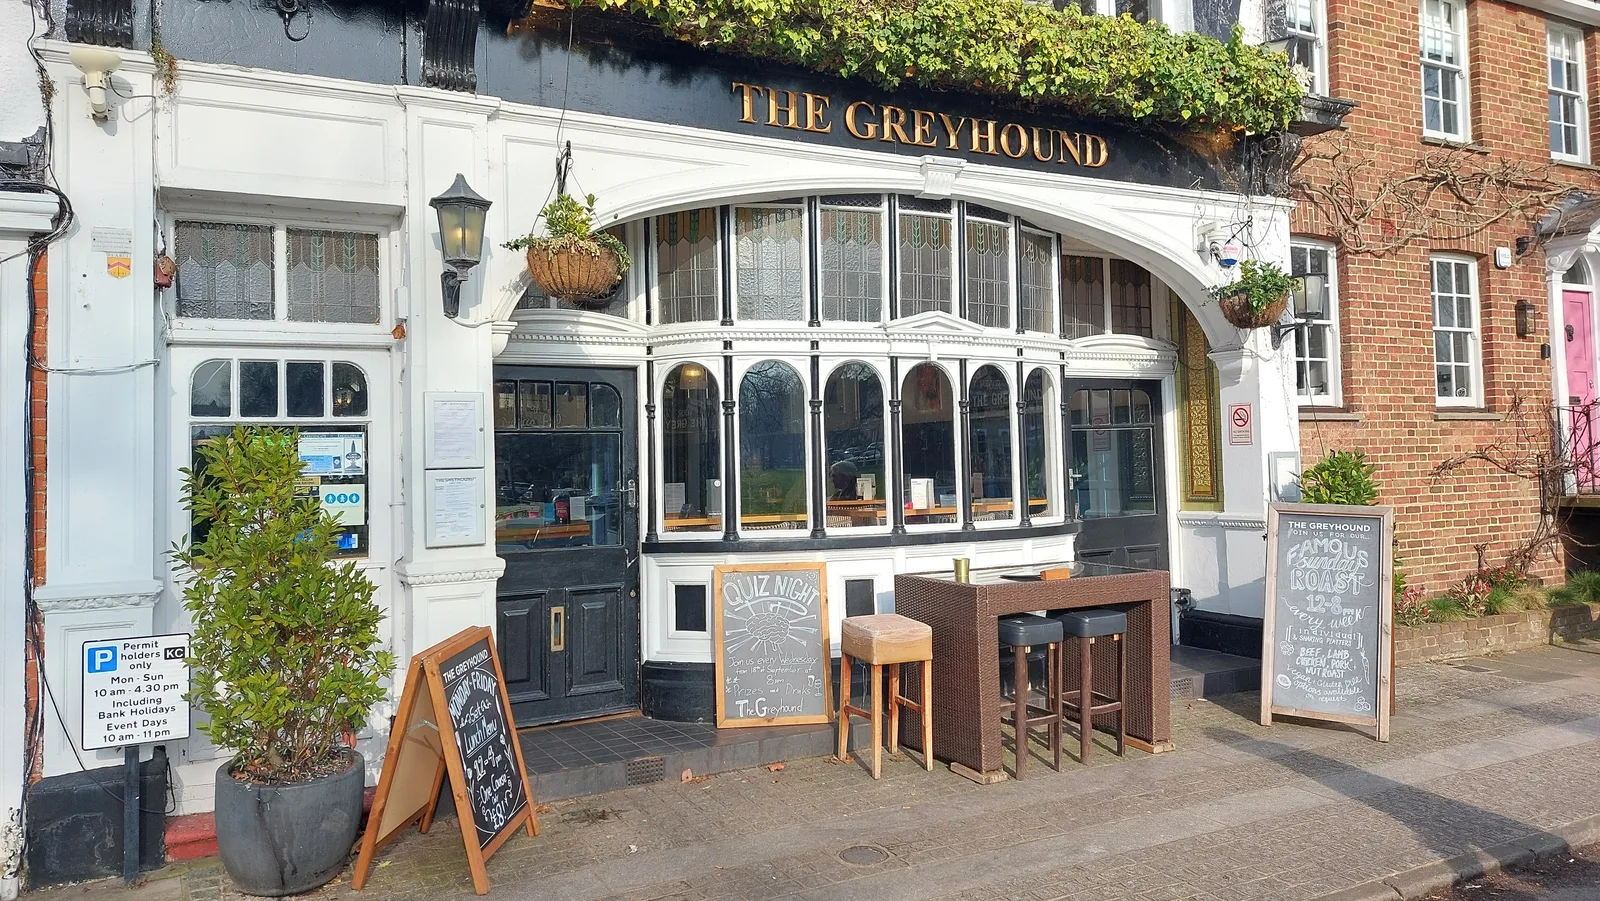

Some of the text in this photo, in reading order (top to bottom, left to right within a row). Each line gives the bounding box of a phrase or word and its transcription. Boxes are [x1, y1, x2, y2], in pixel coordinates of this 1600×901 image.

[732, 81, 1109, 168] THE GREYHOUND
[1288, 521, 1371, 532] THE GREYHOUND
[1286, 537, 1369, 567] FAMOUS
[1290, 568, 1365, 595] ROAST
[723, 575, 820, 607] QUIZ NIGHT
[1289, 605, 1364, 630] every week
[1299, 635, 1323, 643] SHARING
[123, 641, 159, 651] Permit
[95, 650, 113, 670] P
[121, 651, 161, 661] holders
[166, 648, 184, 659] KC
[129, 661, 152, 670] only
[443, 649, 488, 683] THE GREYHOUND
[728, 656, 744, 668] Join
[745, 657, 754, 666] us
[757, 657, 777, 666] every
[111, 677, 134, 685] Mon
[143, 673, 164, 682] Sun
[1306, 667, 1346, 679] NUT ROAST
[94, 689, 107, 698] 10
[109, 688, 126, 696] am
[134, 684, 161, 694] 4.30
[163, 683, 179, 692] pm
[733, 684, 764, 697] Prizes
[785, 682, 811, 695] Drinks
[112, 697, 162, 708] Including
[735, 697, 804, 718] The Greyhound
[98, 705, 176, 720] Bank Holidays
[106, 718, 168, 731] Event Days
[103, 734, 116, 743] 10
[118, 733, 134, 742] am
